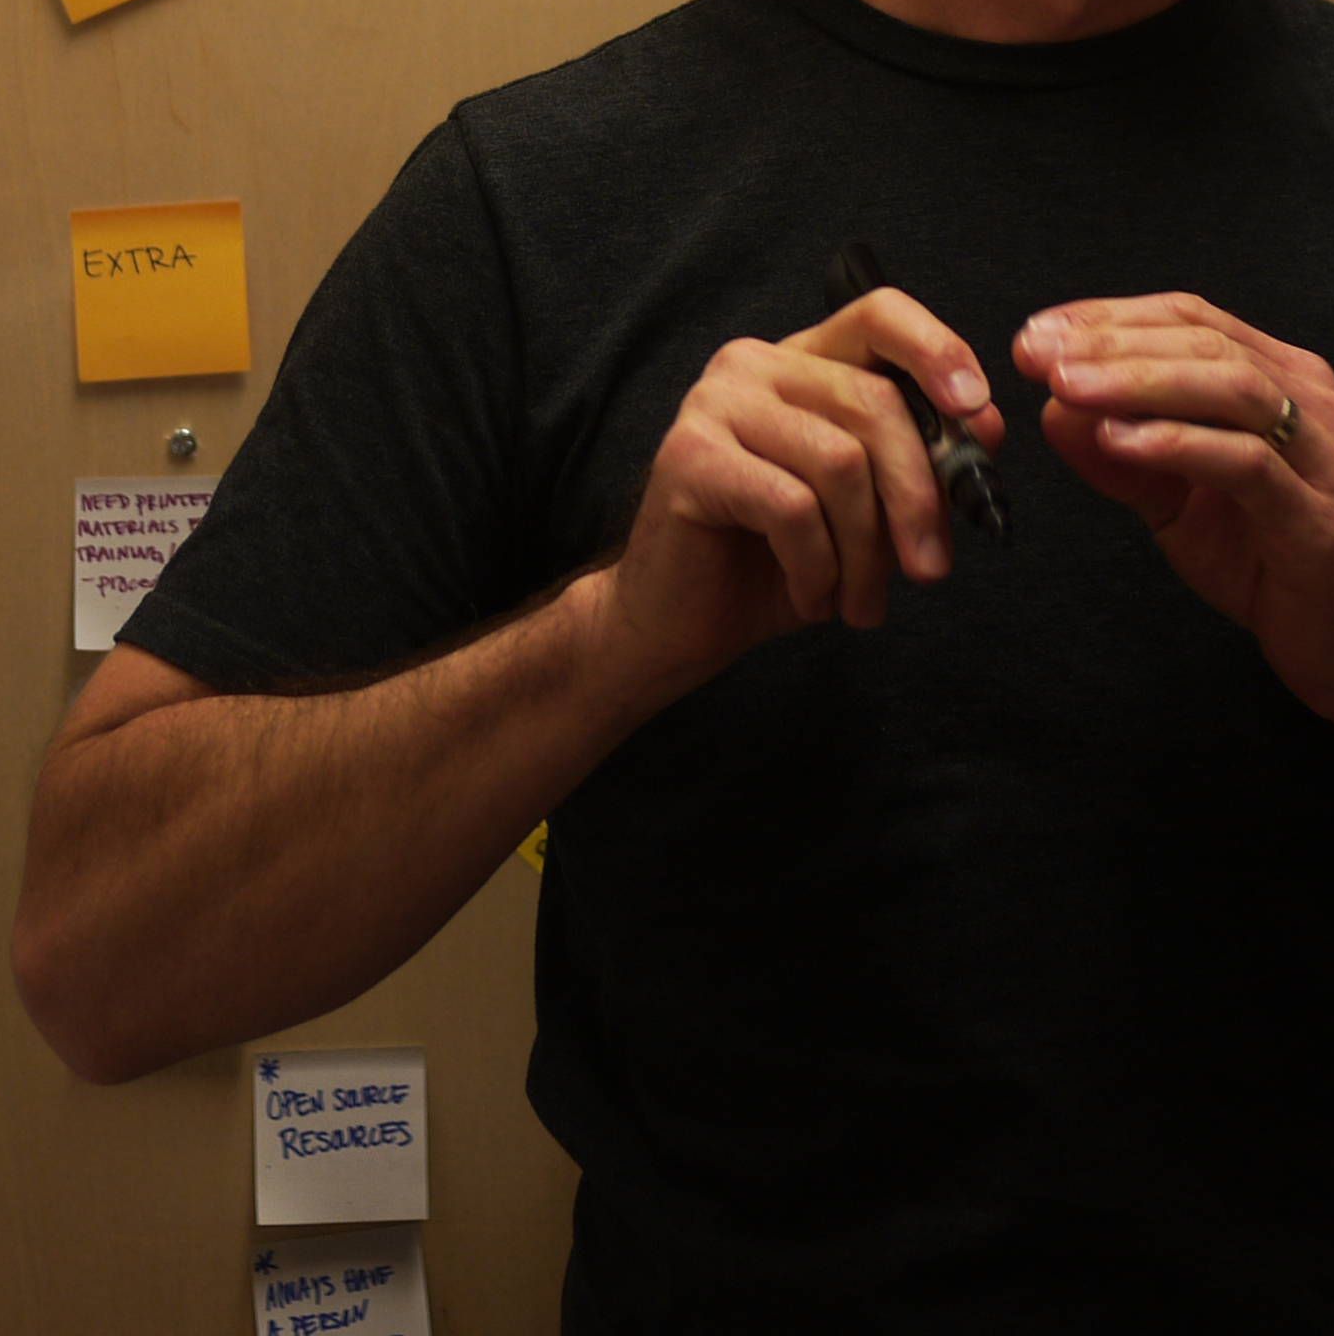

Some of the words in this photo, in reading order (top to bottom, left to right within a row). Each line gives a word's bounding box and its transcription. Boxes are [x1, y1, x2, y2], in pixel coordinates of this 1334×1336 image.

[82, 242, 199, 279] EXTRA
[80, 491, 131, 513] NEED
[77, 518, 181, 538] MATERIALS
[74, 543, 166, 564] TRAINING
[265, 1088, 326, 1122] OPEN
[331, 1083, 412, 1112] SOURCE
[277, 1120, 415, 1161] RESOURCES
